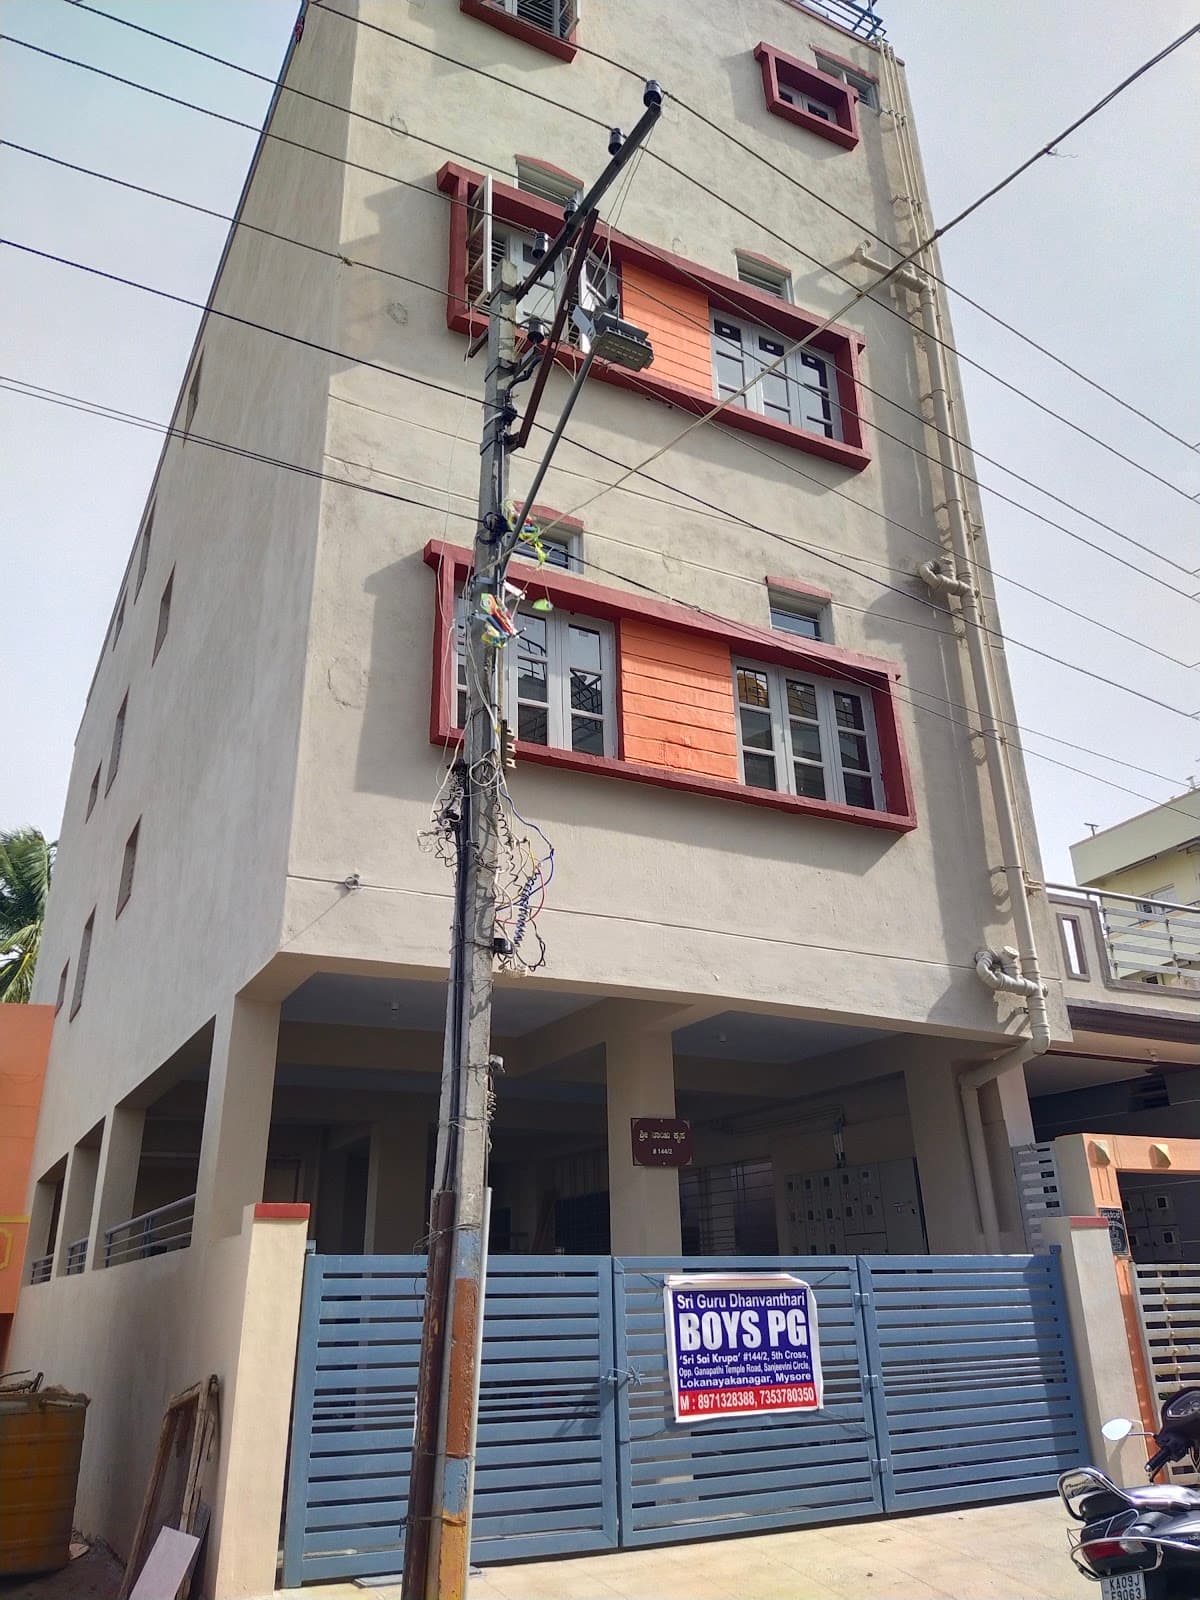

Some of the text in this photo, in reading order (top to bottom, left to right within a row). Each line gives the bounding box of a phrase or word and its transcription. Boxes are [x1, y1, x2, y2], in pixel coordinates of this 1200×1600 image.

[677, 1292, 805, 1309] Sri Guru Dhanvanthari
[679, 1309, 808, 1351] BOYS PG
[696, 1353, 710, 1364] Sai
[743, 1351, 770, 1362] #144/2,
[771, 1351, 783, 1360] 5th
[784, 1350, 809, 1360] Cross,
[679, 1360, 811, 1379] Opp. Ganapathi Temple Road, Sanjeevini Circle,
[680, 1372, 812, 1388] Lokanayakanagar, Mysore
[680, 1395, 690, 1411] M
[697, 1390, 758, 1410] 8971328388,
[760, 1386, 815, 1405] 7353780350
[1110, 1574, 1140, 1591] KA09J
